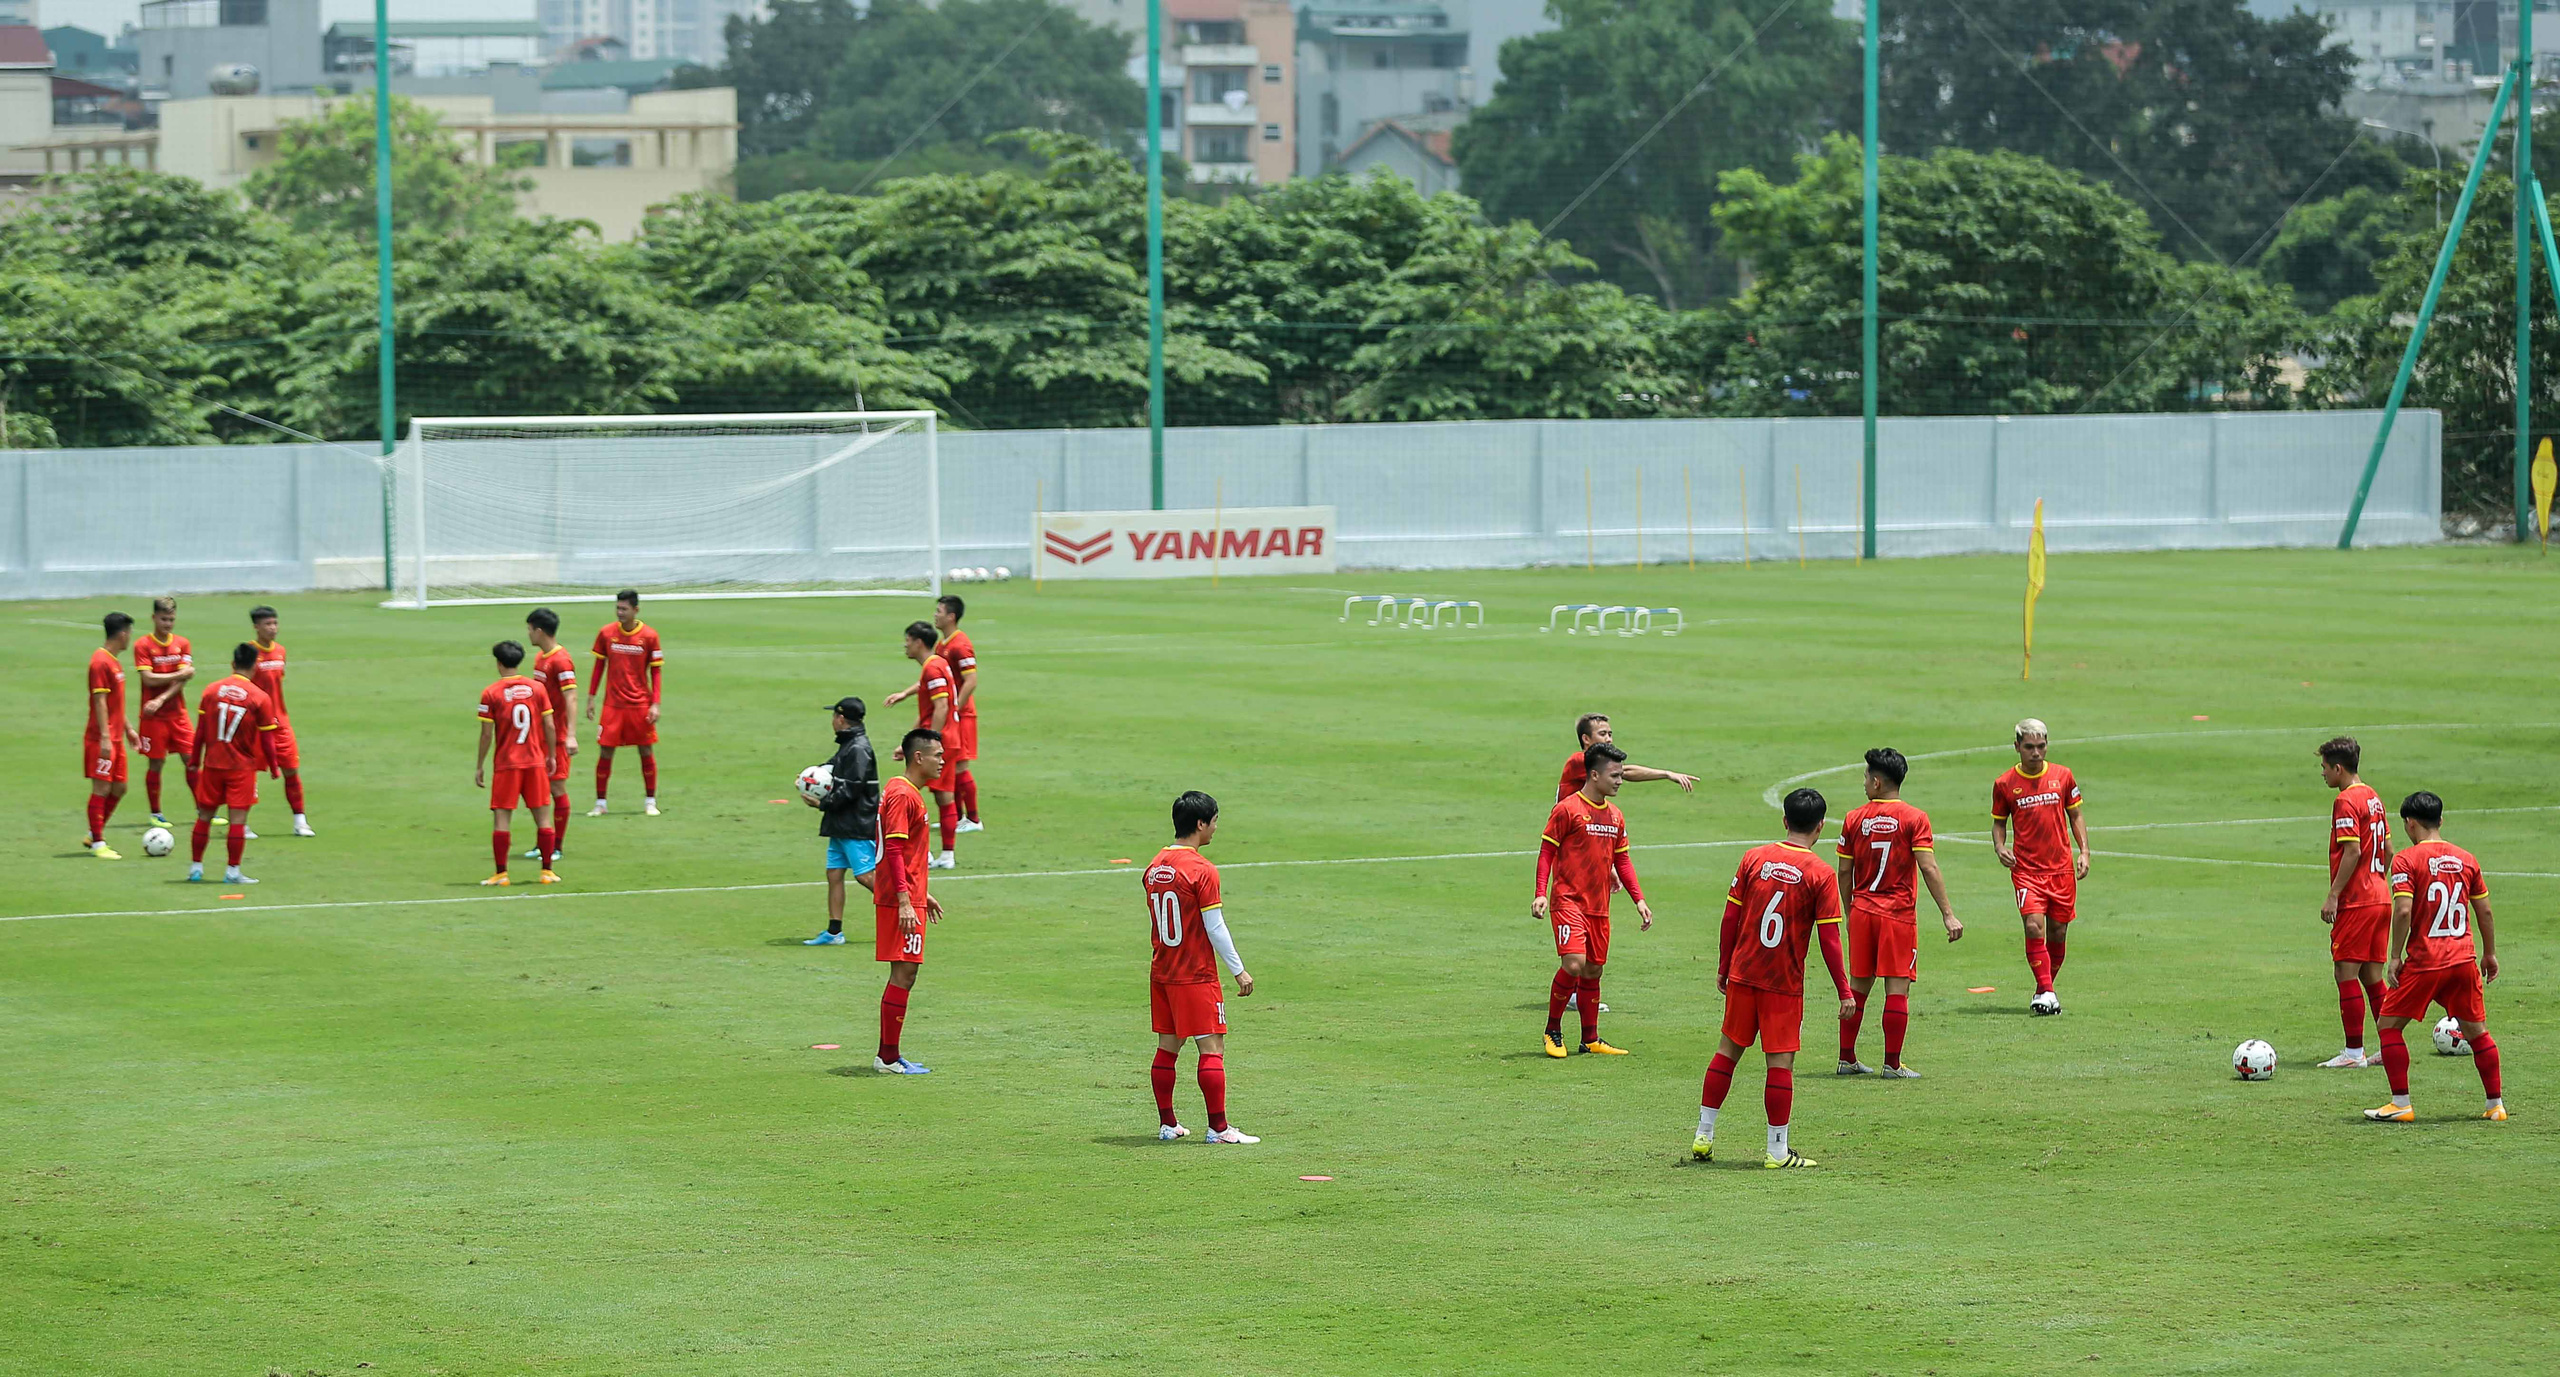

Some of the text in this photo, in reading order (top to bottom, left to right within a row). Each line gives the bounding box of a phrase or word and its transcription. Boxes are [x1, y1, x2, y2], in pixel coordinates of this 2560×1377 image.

[1127, 528, 1324, 561] YANMAR
[217, 701, 248, 743] 17
[512, 703, 531, 744] 9
[2016, 792, 2060, 806] HONDA
[1869, 841, 1892, 892] 7
[2369, 820, 2385, 873] 13
[1150, 890, 1183, 947] 10
[1759, 890, 1785, 948] 6
[2427, 881, 2467, 938] 26
[903, 933, 922, 954] 30
[1557, 924, 1571, 945] 19
